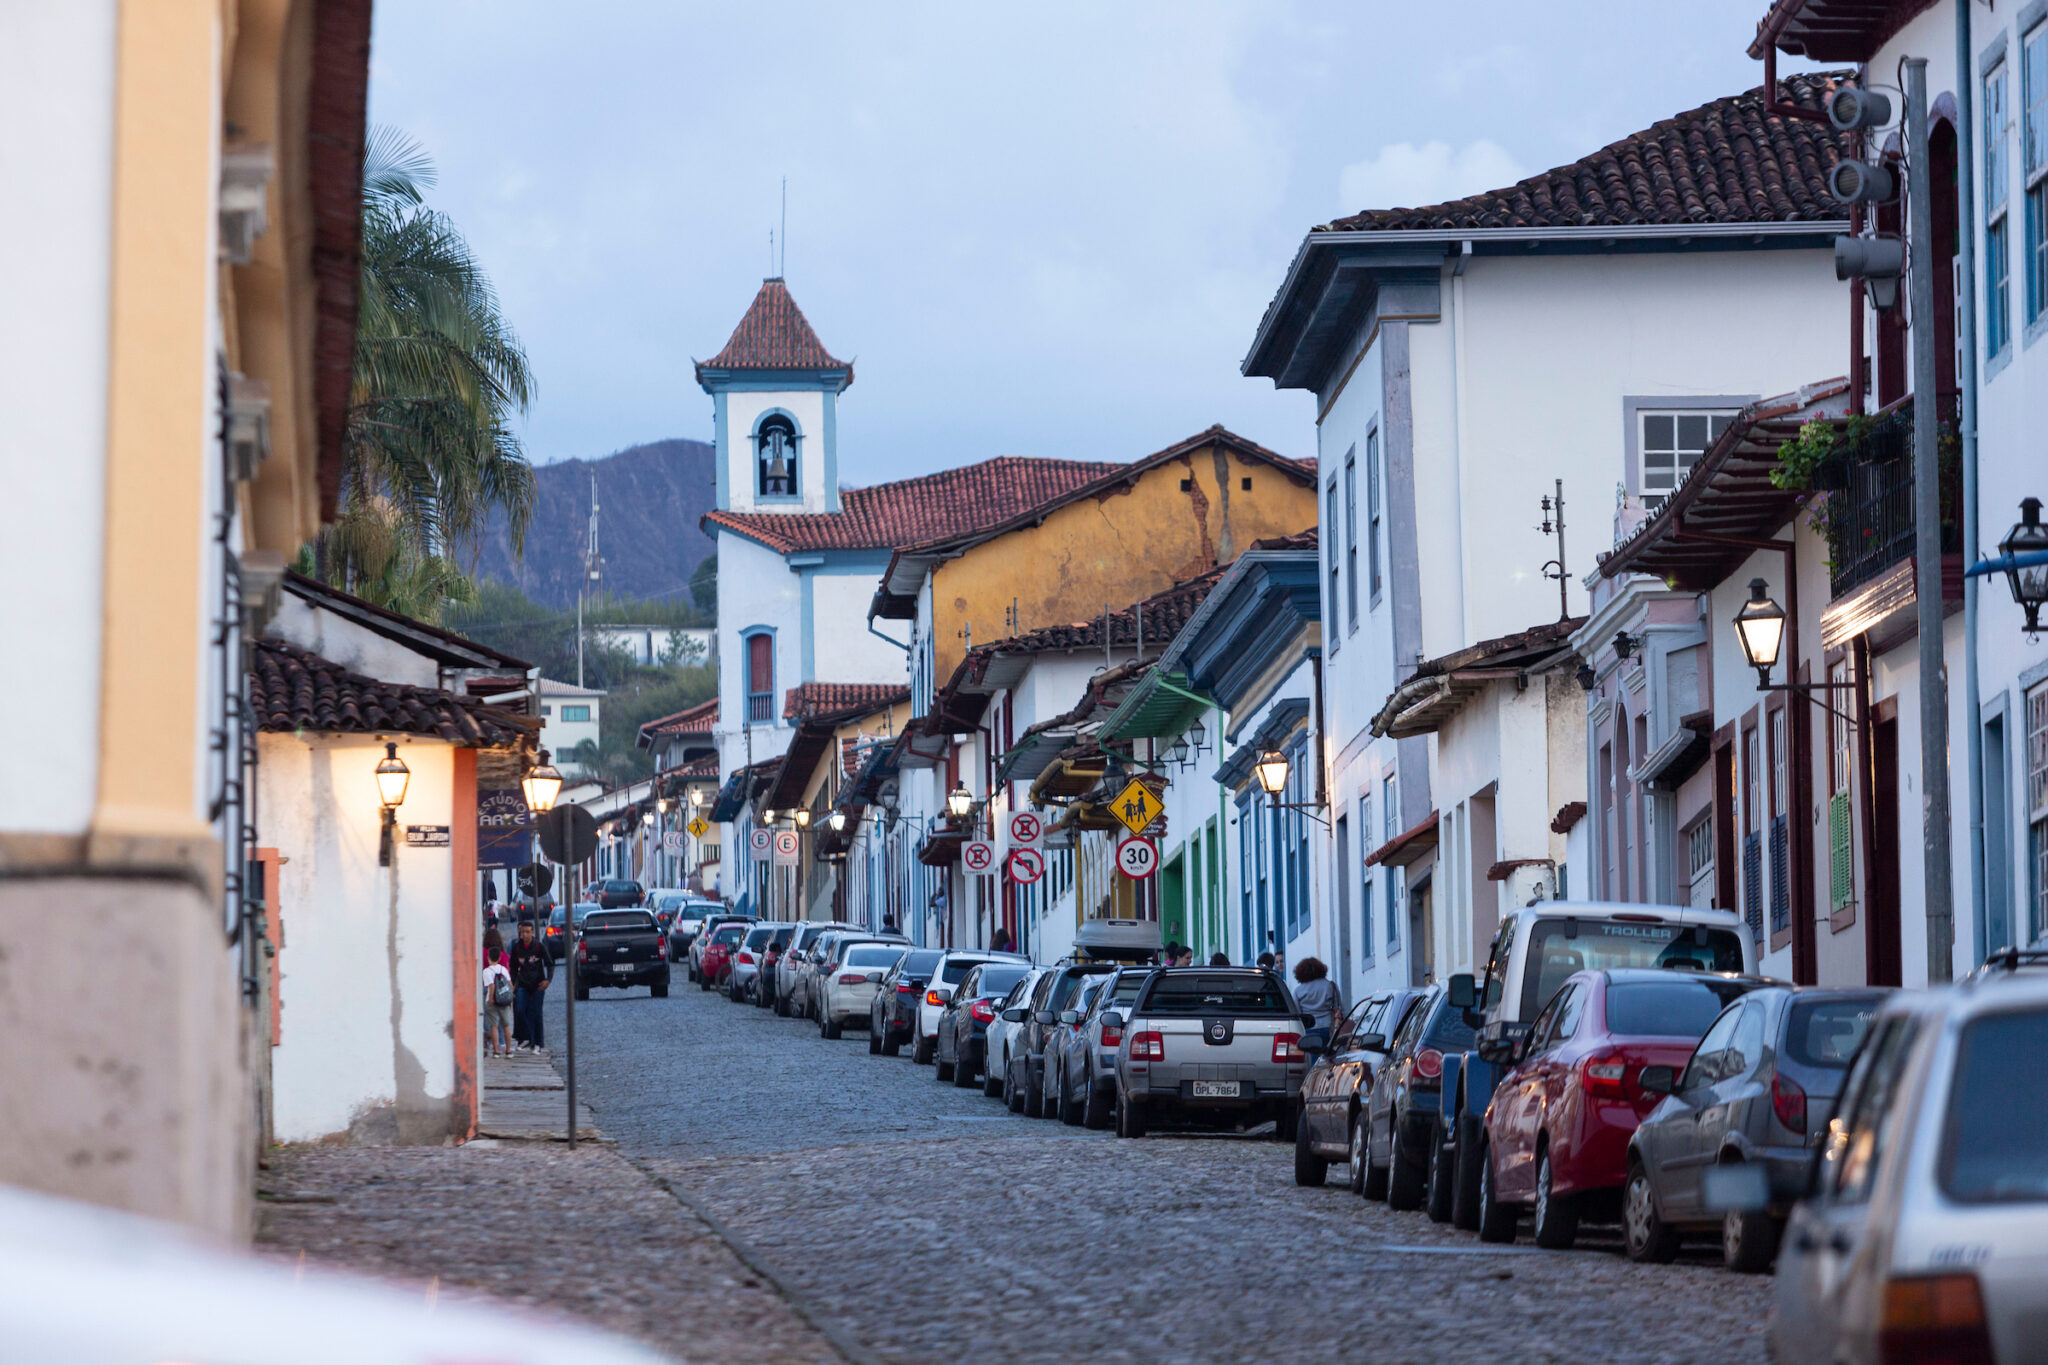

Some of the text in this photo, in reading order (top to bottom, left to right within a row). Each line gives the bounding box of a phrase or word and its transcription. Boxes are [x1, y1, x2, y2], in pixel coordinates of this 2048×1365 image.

[480, 813, 525, 826] ARTE
[757, 834, 764, 845] E
[783, 838, 791, 849] E
[1126, 848, 1149, 864] 30
[1601, 925, 1672, 938] TROLLER
